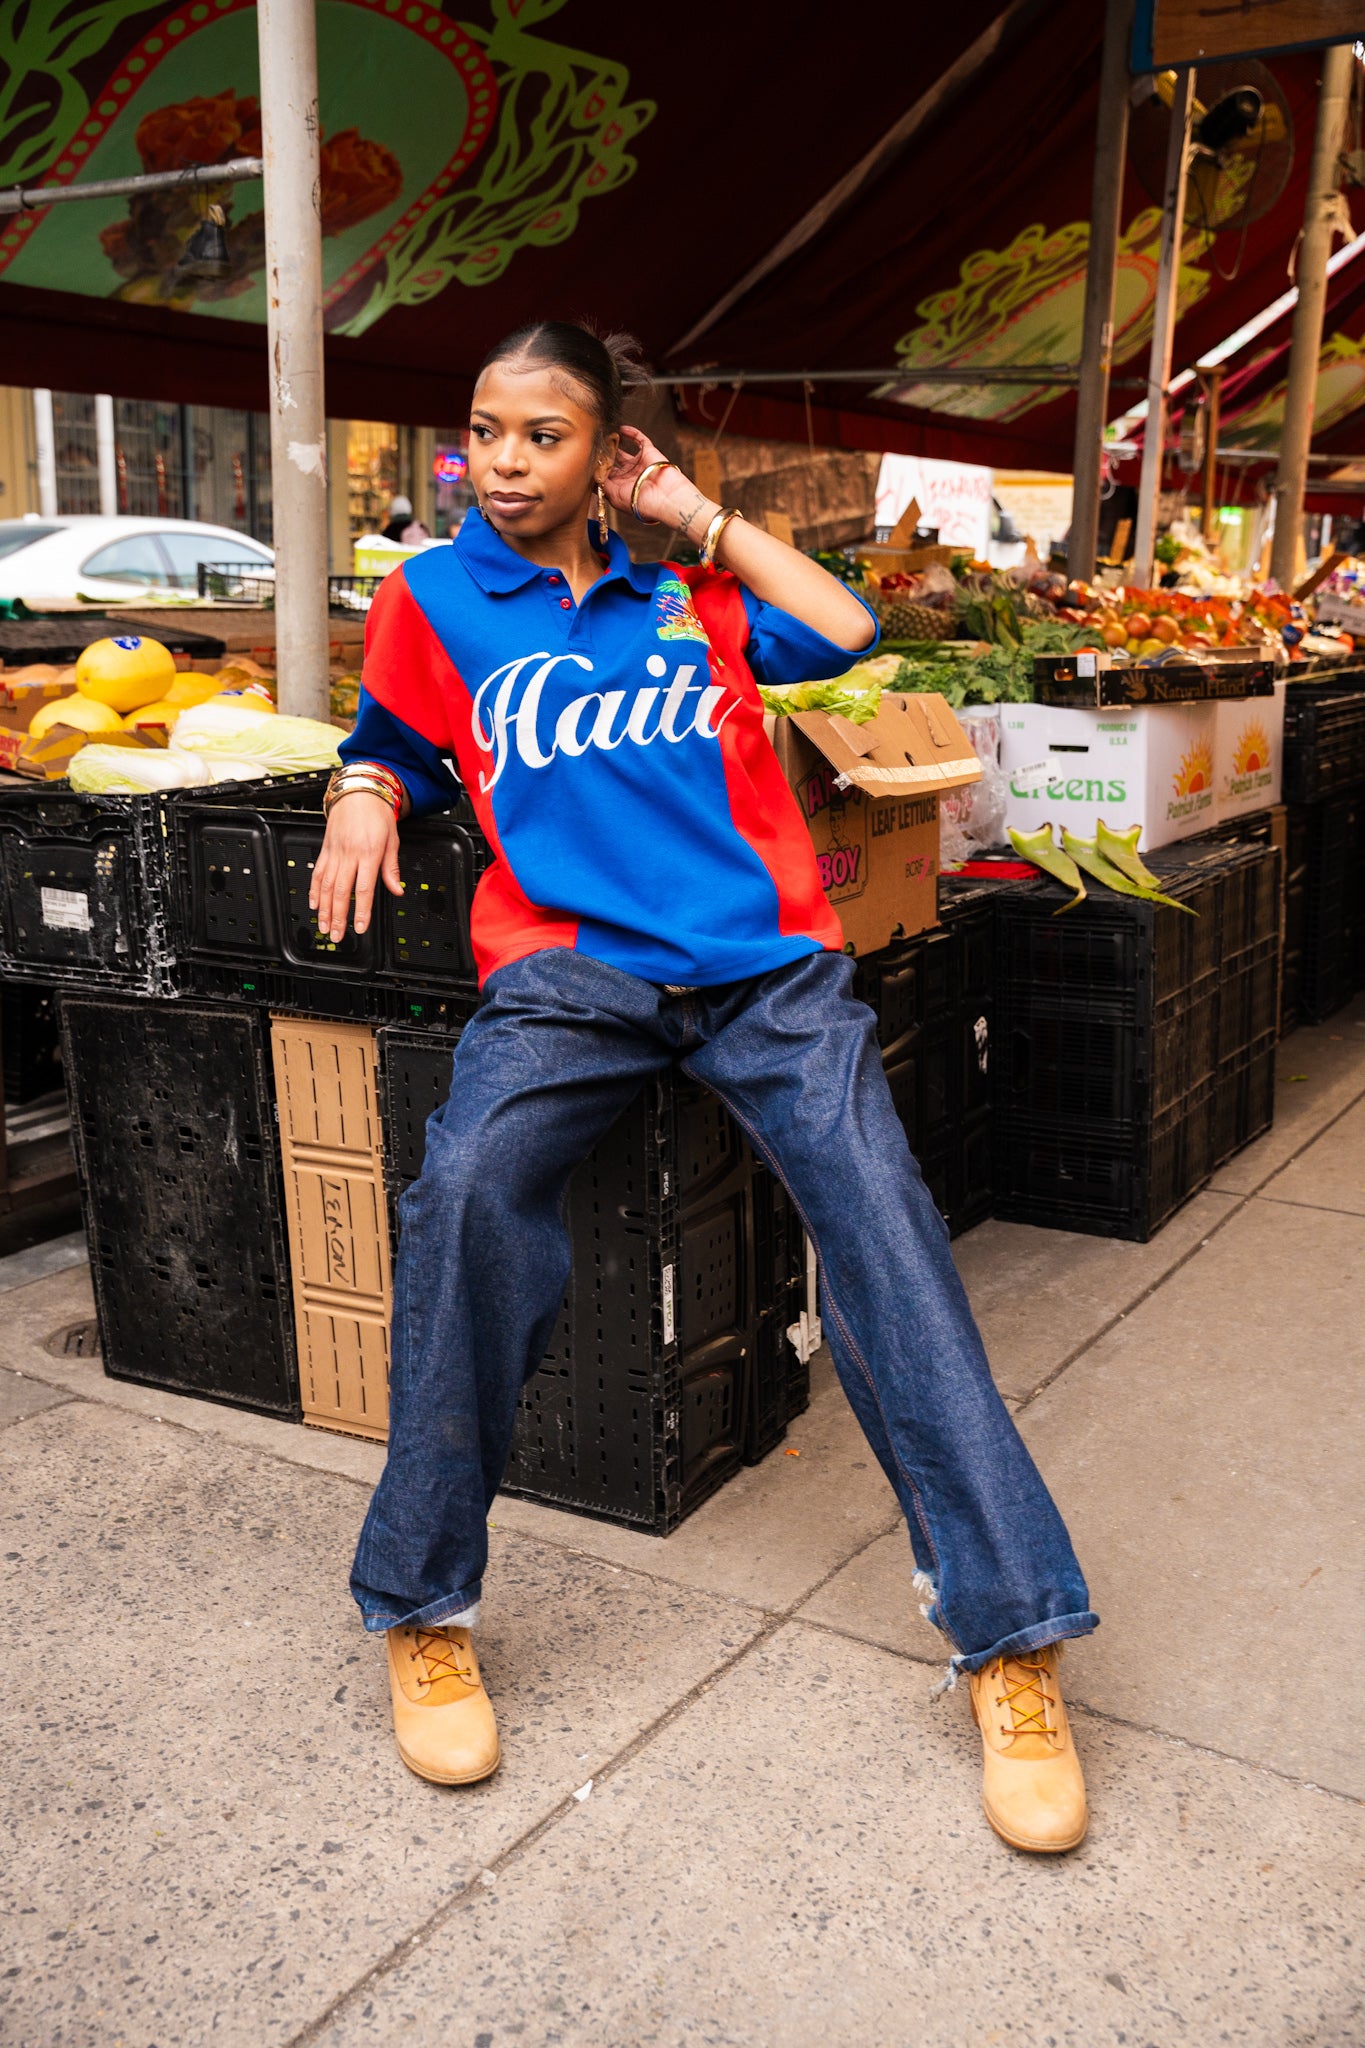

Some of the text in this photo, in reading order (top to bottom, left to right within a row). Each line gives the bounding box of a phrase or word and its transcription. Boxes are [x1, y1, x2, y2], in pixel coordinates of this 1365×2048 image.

[1153, 677, 1246, 700] Natural Hand
[1096, 722, 1127, 732] PRODUCE
[871, 806, 896, 838] LEAF
[898, 796, 937, 831] LETTUCE
[817, 844, 861, 891] BOY
[662, 1171, 670, 1196] IFCO
